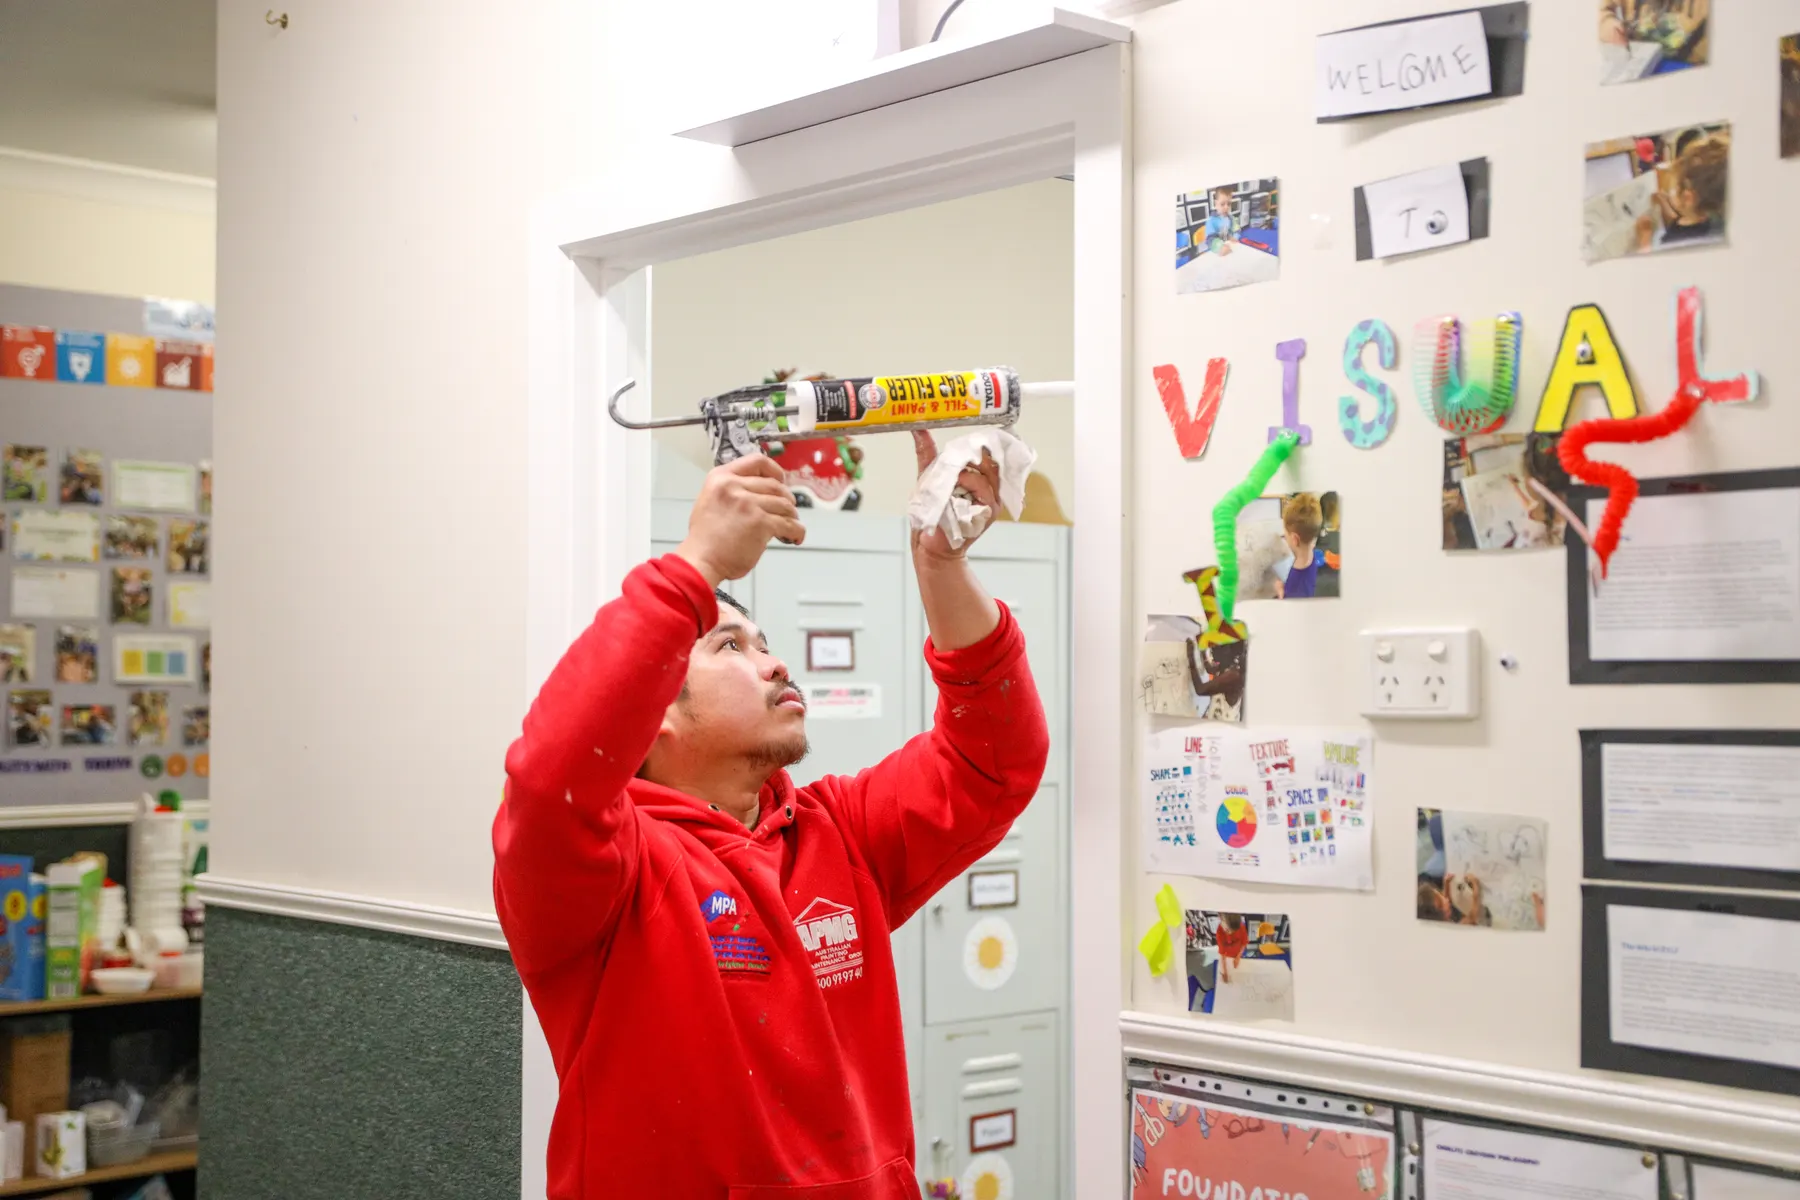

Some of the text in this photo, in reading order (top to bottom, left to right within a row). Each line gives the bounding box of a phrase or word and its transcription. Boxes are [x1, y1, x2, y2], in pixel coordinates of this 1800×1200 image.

[1326, 43, 1480, 96] WELCOME
[1153, 285, 1760, 459] VISUAL
[889, 375, 935, 401] FILLER
[937, 374, 967, 398] GAP
[890, 399, 968, 416] FILL & PAINT
[1184, 736, 1203, 753] LINE
[1249, 738, 1291, 761] TEXTURE
[1150, 768, 1172, 781] SHAPE
[1286, 787, 1314, 807] SPACE
[711, 896, 737, 915] MPA
[795, 913, 858, 952] APMG
[815, 943, 852, 957] AUSTRALIAN
[820, 950, 848, 961] PAINTING
